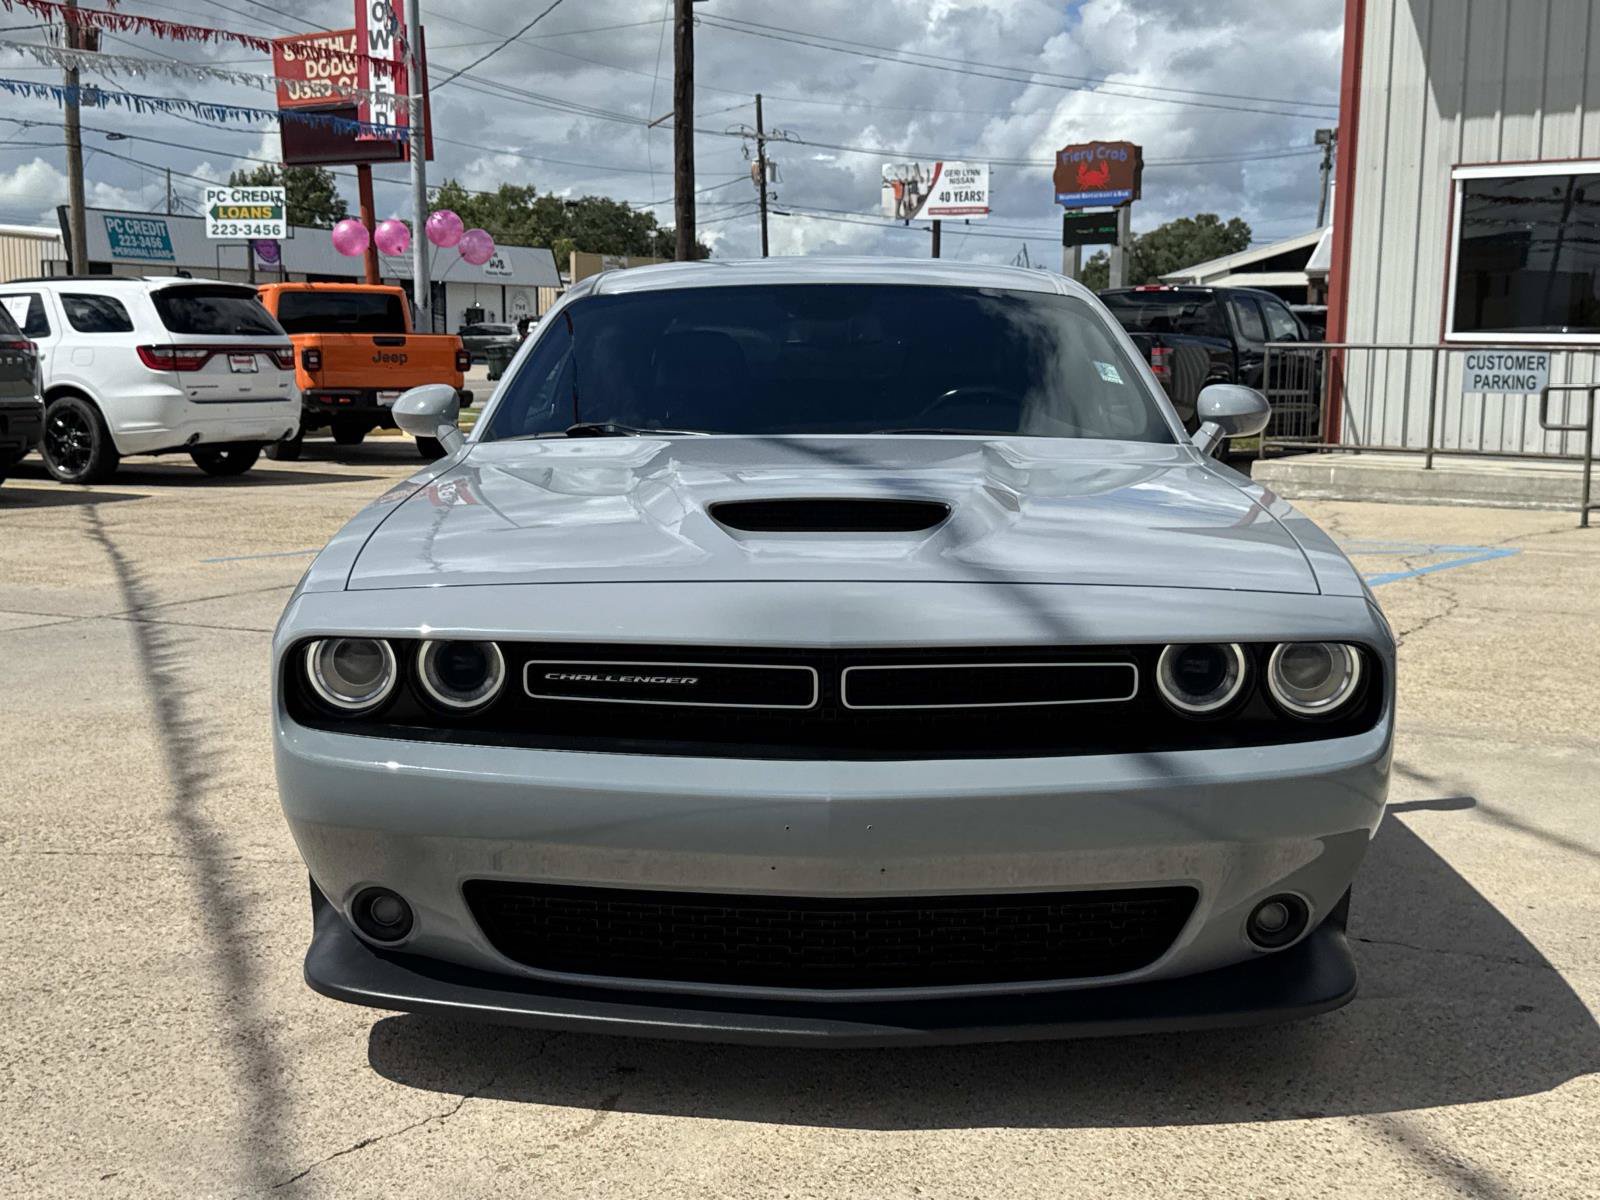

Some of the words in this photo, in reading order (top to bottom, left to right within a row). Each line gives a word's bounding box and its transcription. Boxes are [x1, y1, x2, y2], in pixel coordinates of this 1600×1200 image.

[1097, 146, 1127, 161] Crab
[949, 177, 975, 185] NISSAN
[207, 190, 226, 203] PC
[231, 190, 283, 203] CREDIT
[939, 192, 951, 202] 40
[954, 191, 985, 203] YEARS!
[219, 206, 273, 219] LOANS
[105, 218, 124, 233] PC
[125, 220, 166, 236] CREDIT
[211, 223, 281, 236] 223-3456
[118, 234, 164, 249] 223-3456
[372, 350, 408, 366] Jeep
[1466, 355, 1546, 371] CUSTOMER
[1473, 374, 1537, 390] PARKING
[545, 673, 698, 684] CHALLENGER
